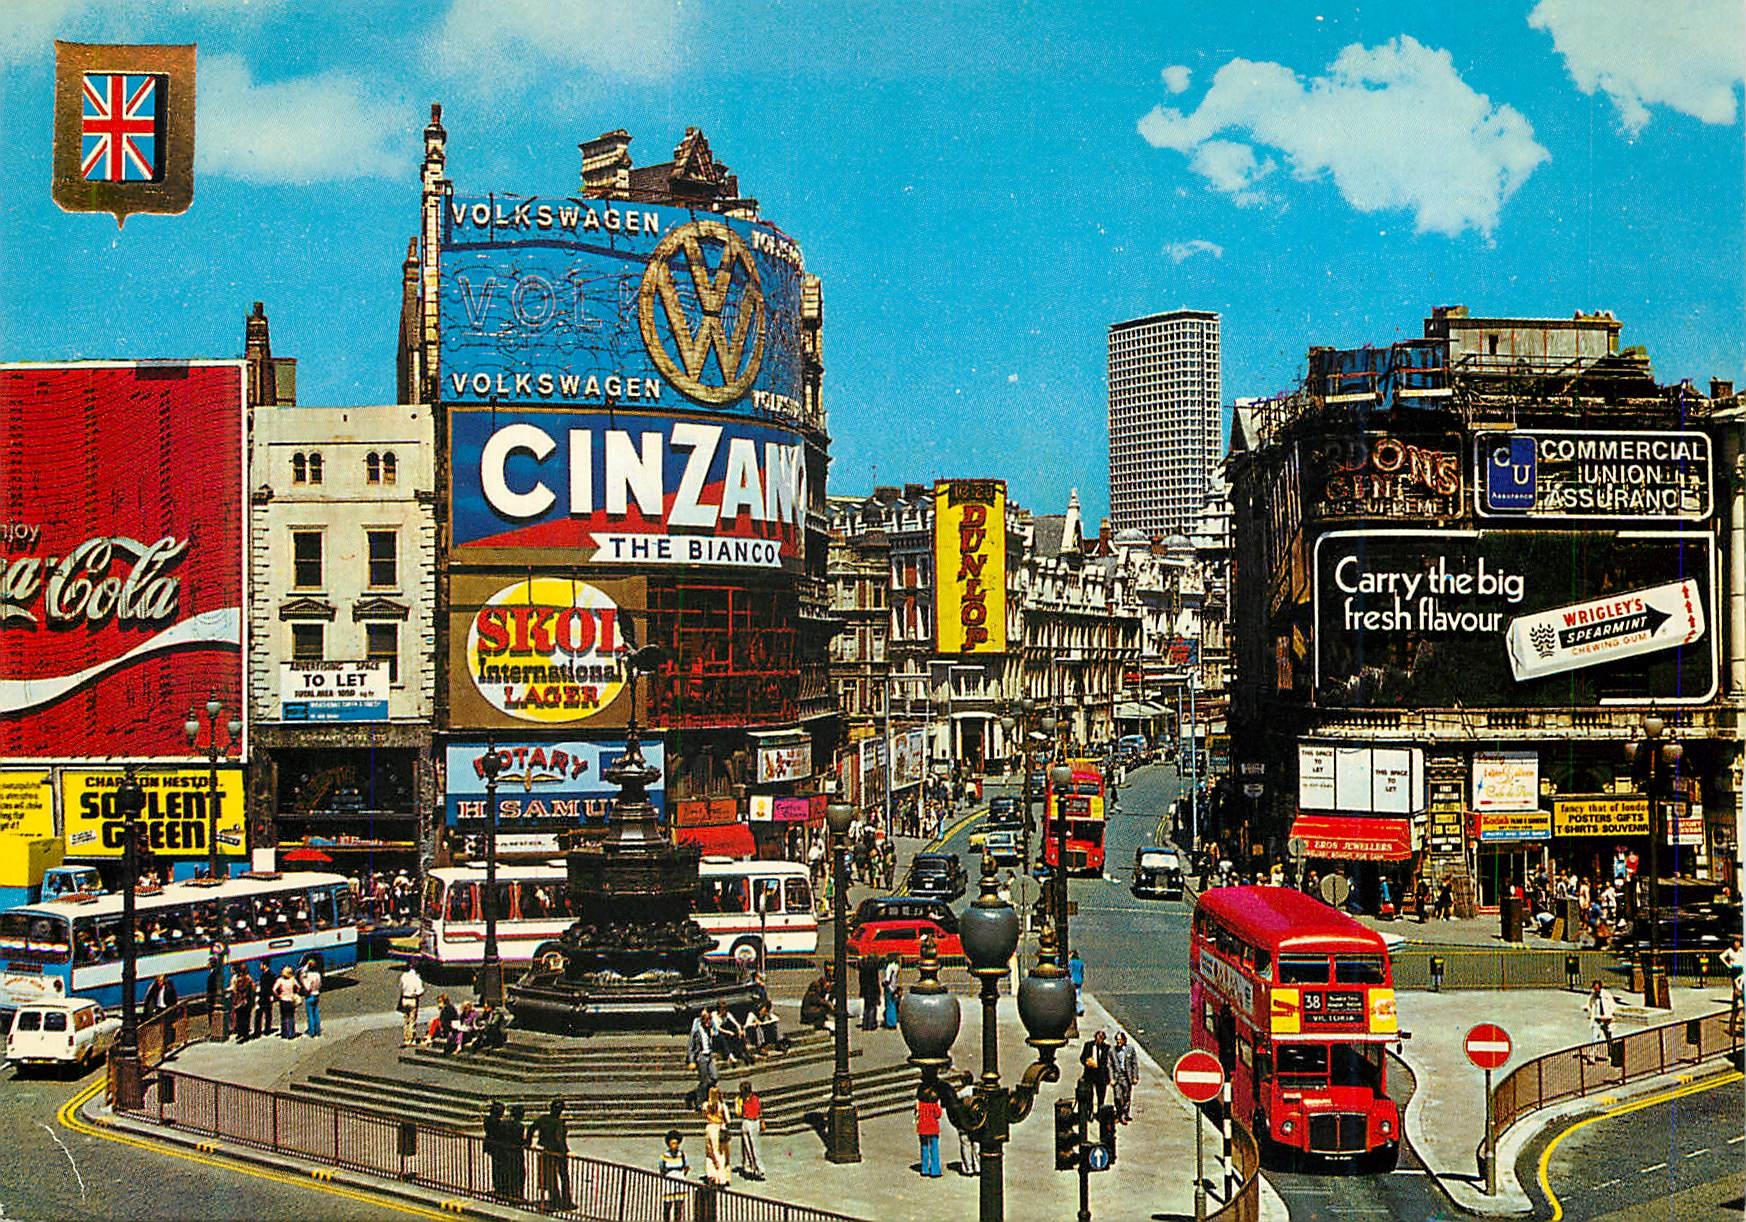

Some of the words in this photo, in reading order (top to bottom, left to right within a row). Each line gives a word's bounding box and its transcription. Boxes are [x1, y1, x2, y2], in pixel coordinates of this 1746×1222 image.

[451, 203, 659, 232] VOLKSWAGEN
[452, 373, 660, 399] VOLKSWAGEN
[1540, 439, 1706, 461] COMMERCIAL
[1584, 464, 1661, 484] UNION
[1547, 489, 1695, 509] ASSURANCE
[609, 537, 672, 558] THE
[688, 540, 775, 563] BIANCO
[957, 504, 988, 652] DUNLOP
[1335, 555, 1422, 601] Carry
[1428, 555, 1474, 595] the
[1477, 556, 1525, 603] big
[1344, 596, 1412, 631] fresh
[1419, 596, 1503, 632] flavour
[1562, 598, 1643, 628] WRIGLEY'S
[477, 608, 628, 658] SKOL
[1566, 616, 1648, 644] SPEARMINT
[1571, 638, 1620, 656] CHEWING
[1622, 632, 1648, 645] GUM
[303, 674, 325, 687] TO
[336, 673, 367, 687] LET
[478, 657, 623, 683] International
[504, 685, 599, 709] LAGER
[80, 792, 226, 819] SOLENT
[457, 801, 487, 818] H
[499, 800, 624, 818] SAMU
[1561, 804, 1584, 814] fancy
[1589, 803, 1606, 812] that
[1610, 803, 1618, 811] of
[1568, 814, 1612, 823] POSTERS
[1617, 813, 1644, 822] GIFTS
[1314, 840, 1338, 849] EROS
[1342, 841, 1393, 851] JEWELLERS
[1305, 995, 1321, 1009] 38
